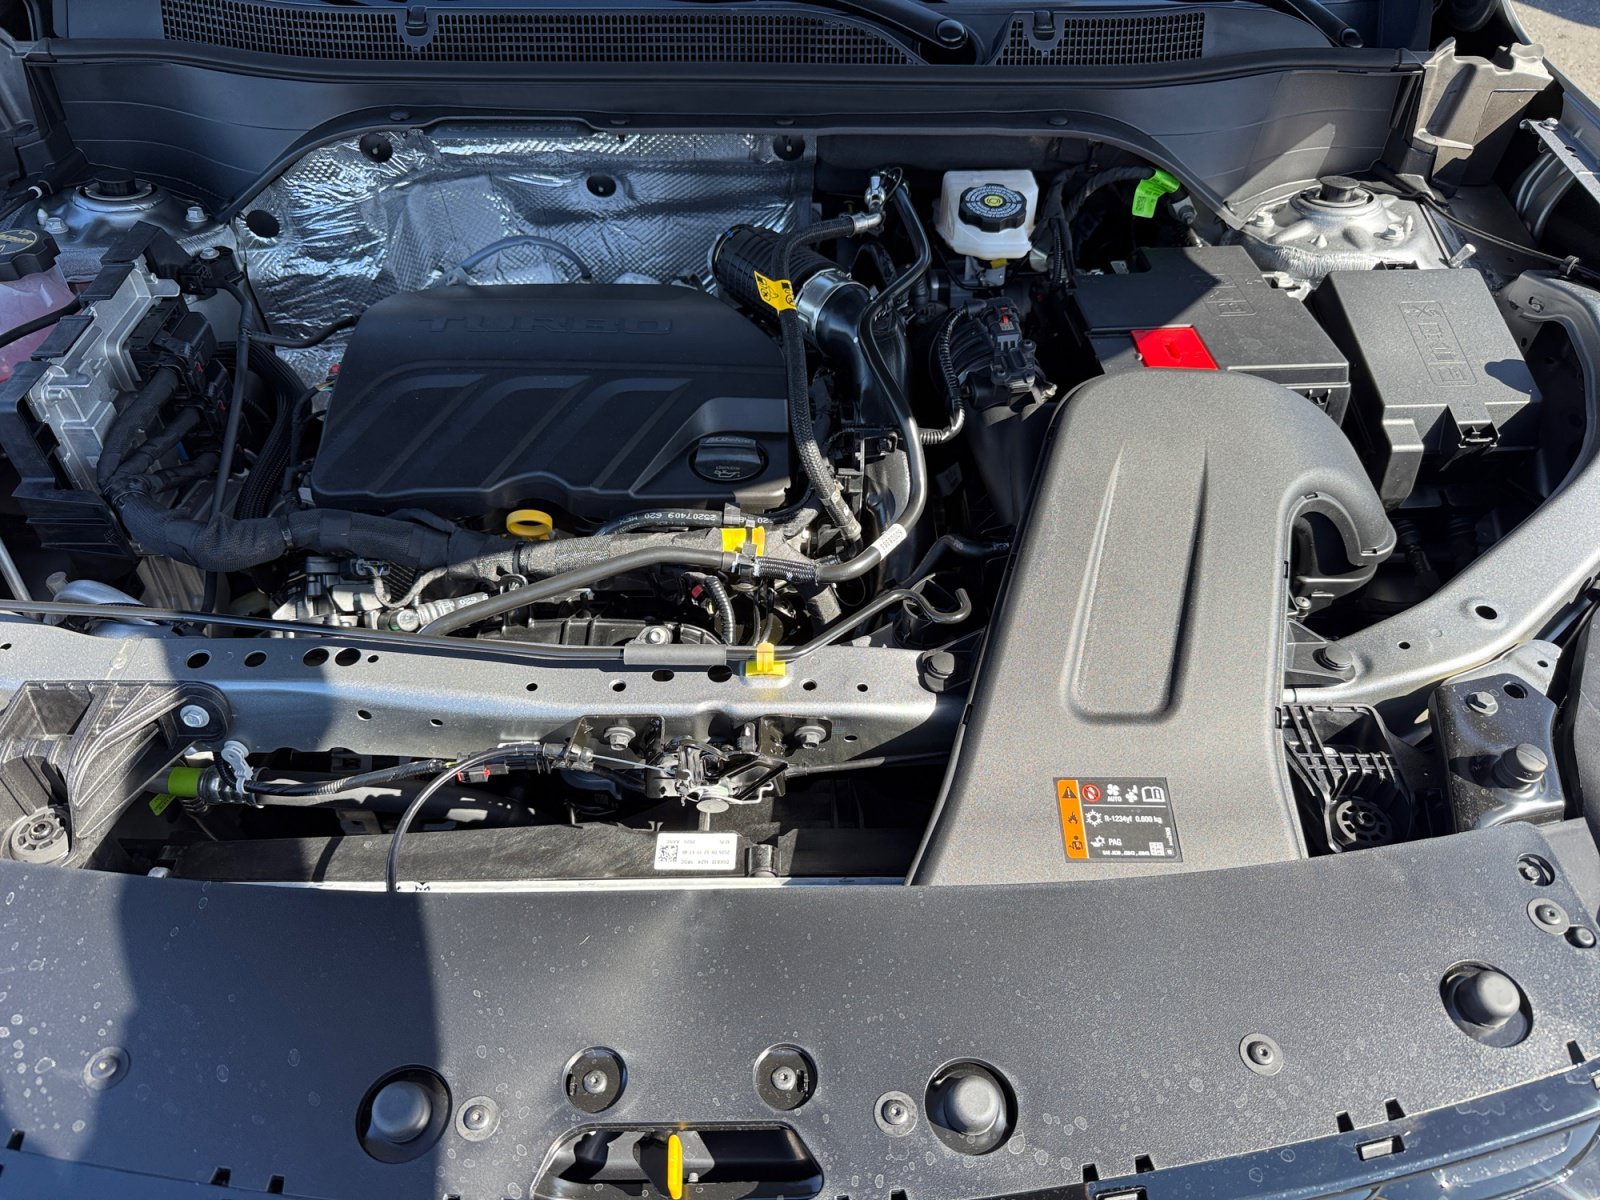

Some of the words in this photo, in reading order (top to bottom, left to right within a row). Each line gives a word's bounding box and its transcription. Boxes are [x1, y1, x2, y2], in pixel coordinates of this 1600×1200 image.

[418, 317, 673, 335] TURBO
[667, 511, 717, 521] 25207409
[1104, 815, 1133, 824] R-1234yf
[1154, 815, 1162, 824] kg
[1108, 838, 1122, 846] PAG
